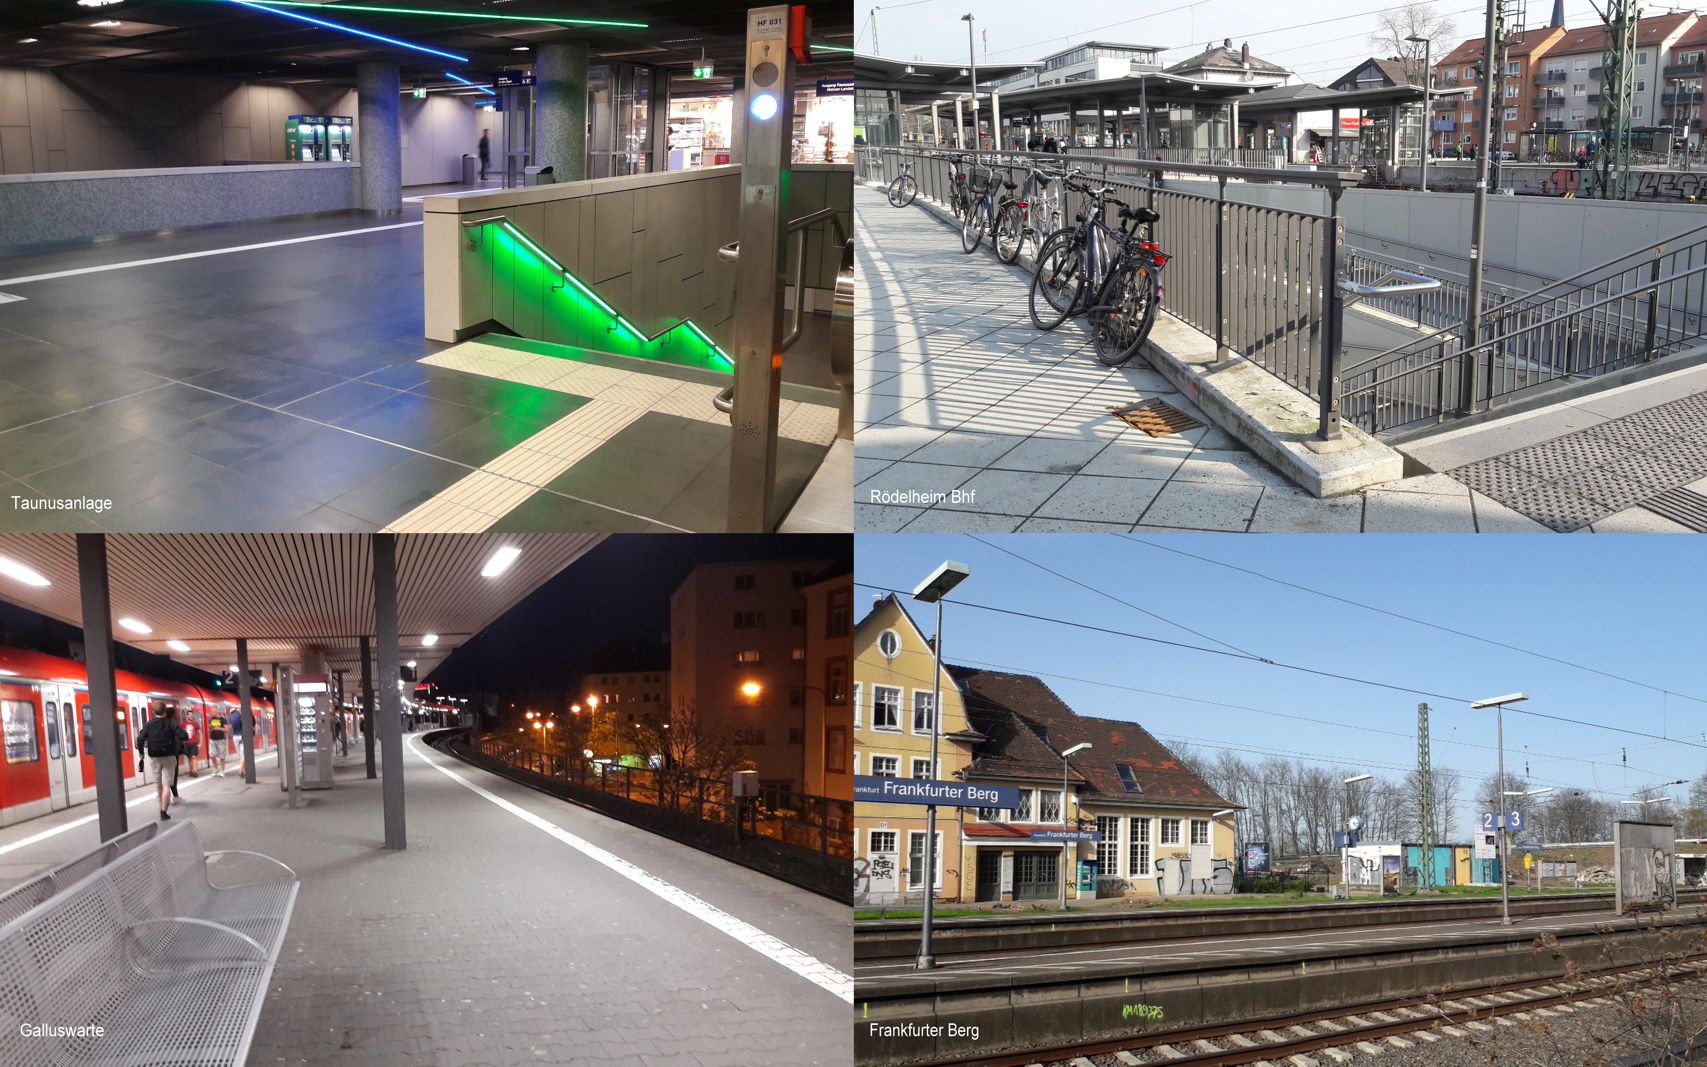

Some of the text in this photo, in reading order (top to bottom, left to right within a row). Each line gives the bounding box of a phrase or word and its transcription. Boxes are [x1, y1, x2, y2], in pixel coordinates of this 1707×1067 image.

[757, 18, 782, 27] HF 031
[225, 671, 233, 684] 2
[854, 781, 999, 803] rankfurt Frankfurter Berg
[1484, 811, 1520, 828] 2 3
[1047, 831, 1079, 839] Frankfurter
